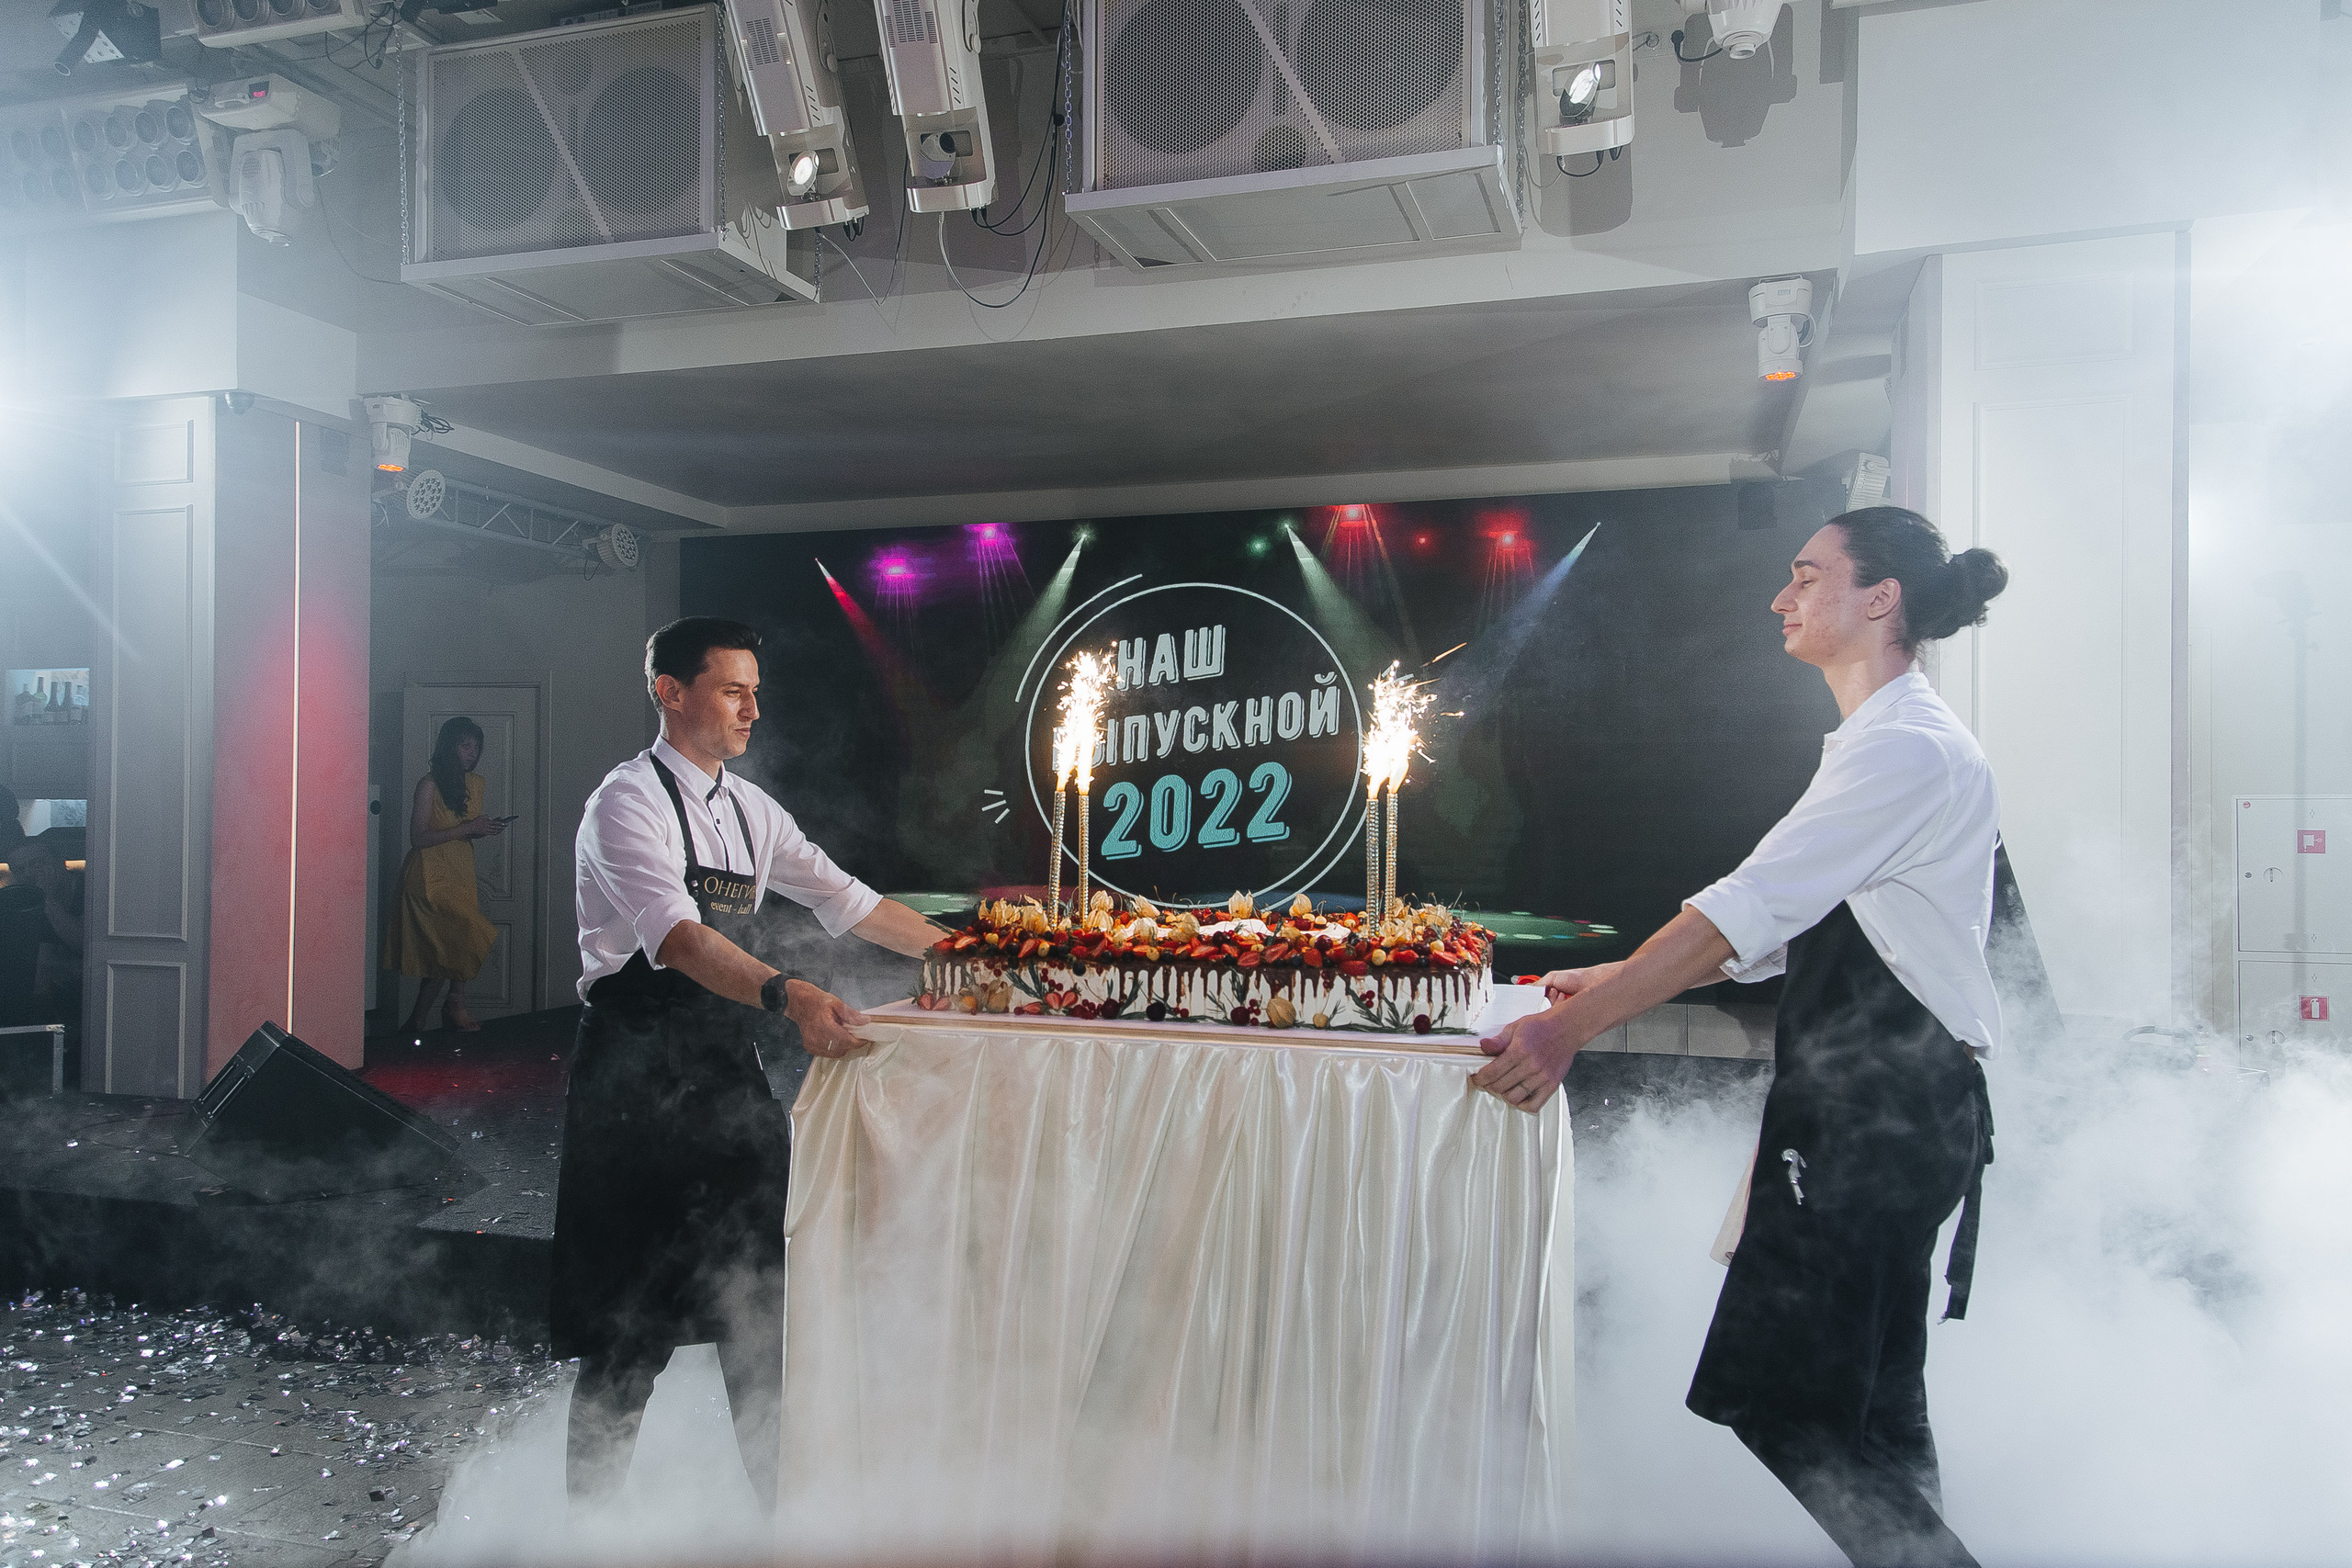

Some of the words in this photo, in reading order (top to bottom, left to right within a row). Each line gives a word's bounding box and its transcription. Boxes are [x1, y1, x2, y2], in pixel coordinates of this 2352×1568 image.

[1115, 625, 1226, 690] НАШ
[1052, 672, 1340, 771] ЫПУСКНОЙ
[1102, 761, 1293, 860] 2022
